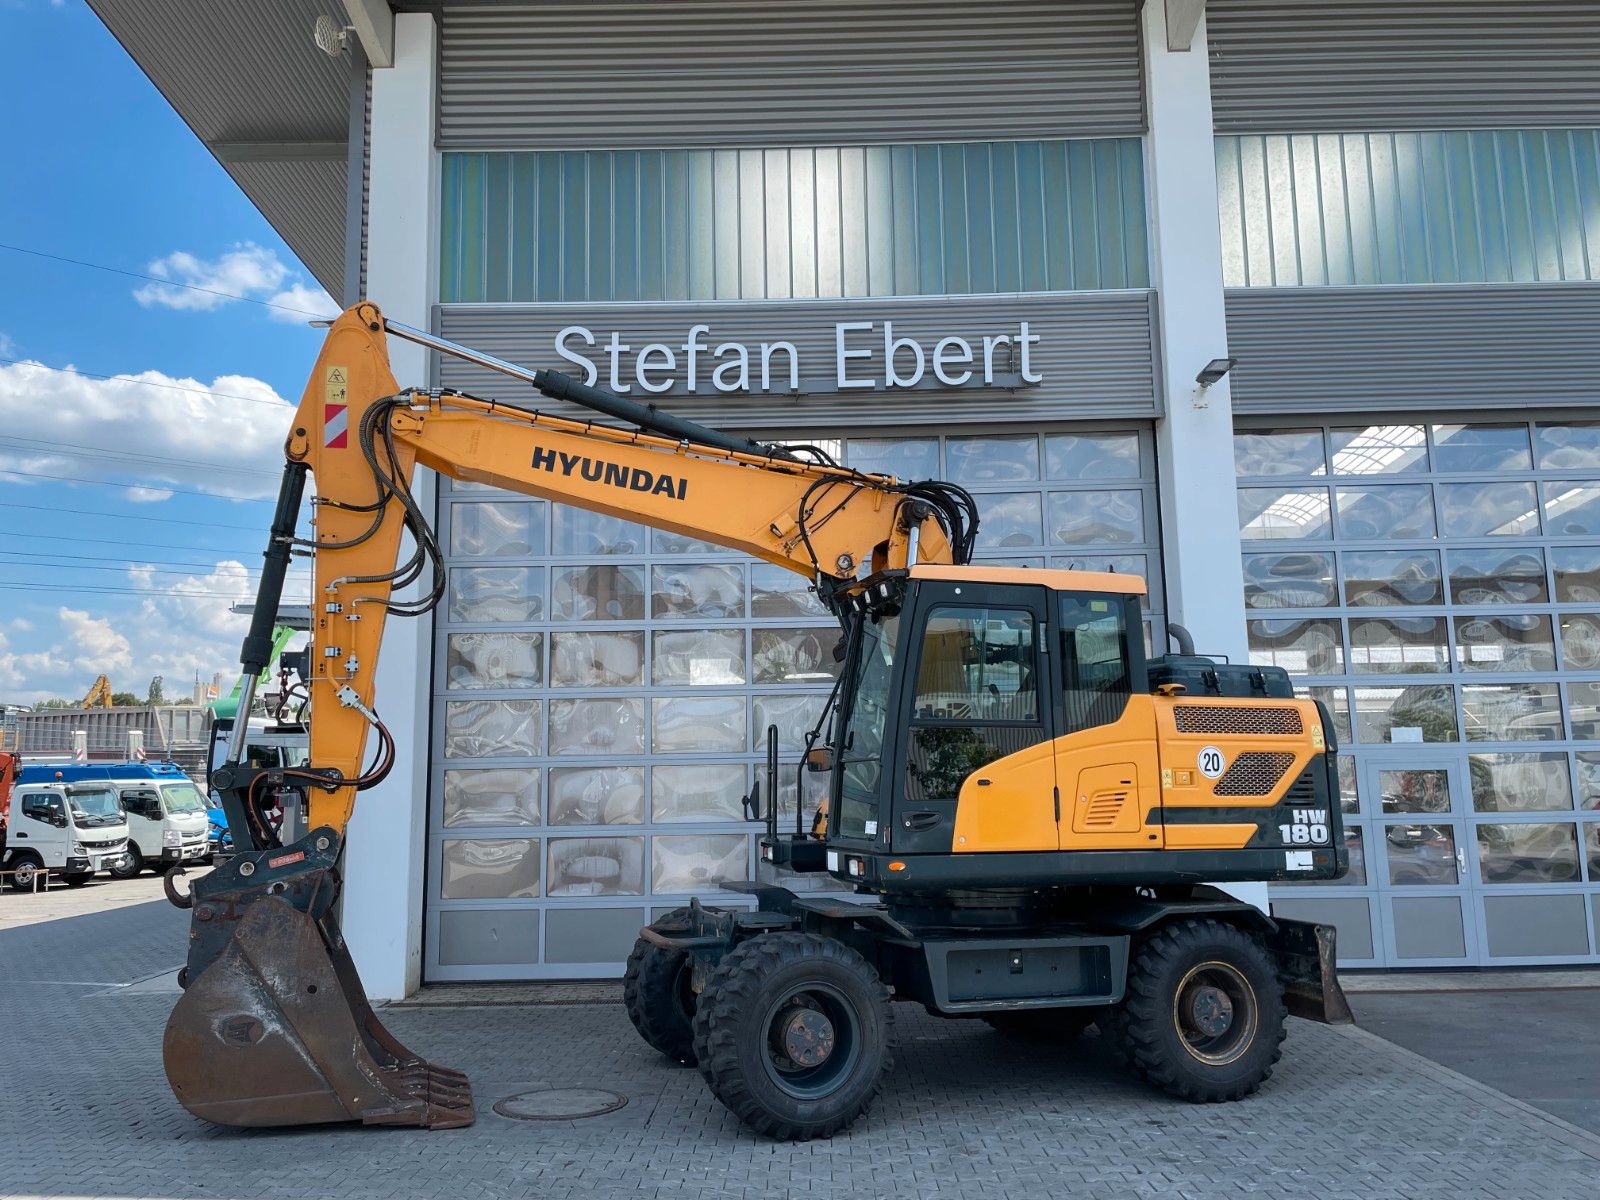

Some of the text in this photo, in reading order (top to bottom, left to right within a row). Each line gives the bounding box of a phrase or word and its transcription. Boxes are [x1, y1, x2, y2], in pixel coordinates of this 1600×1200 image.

[554, 321, 1043, 393] Stefan Ebert
[531, 446, 688, 500] HYUNDAI
[1203, 752, 1220, 772] 20
[1292, 809, 1326, 824] HW
[1278, 824, 1330, 844] 180
